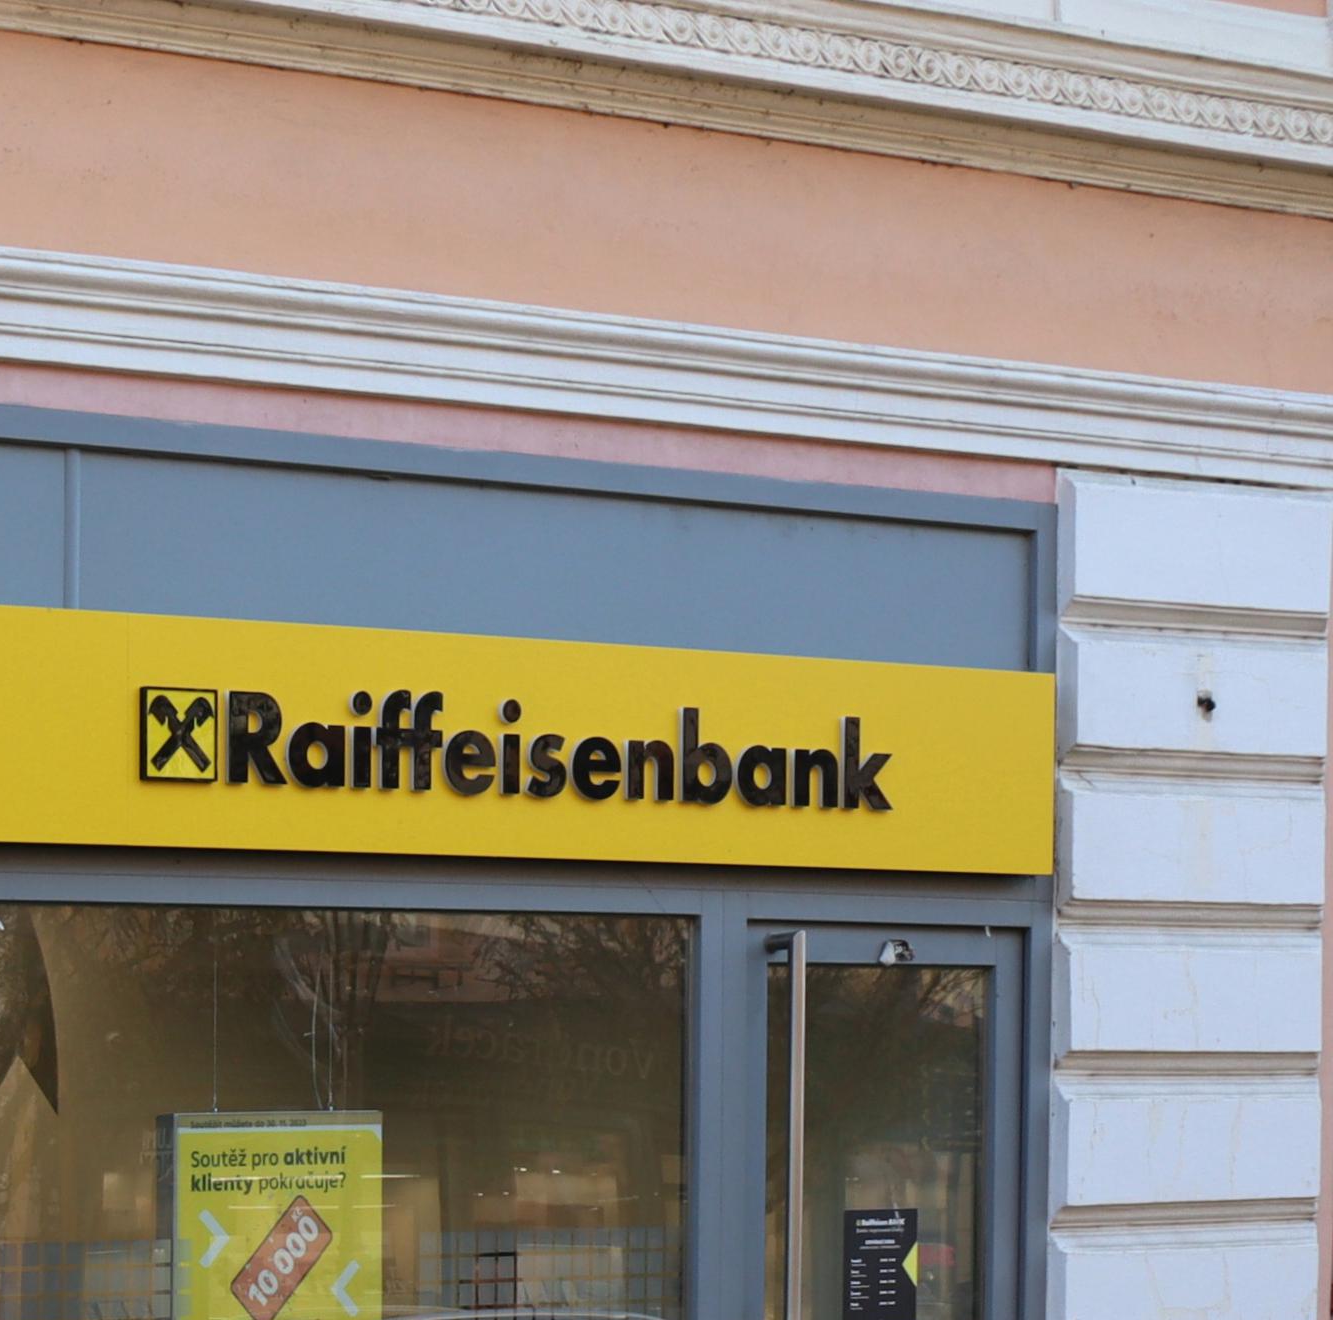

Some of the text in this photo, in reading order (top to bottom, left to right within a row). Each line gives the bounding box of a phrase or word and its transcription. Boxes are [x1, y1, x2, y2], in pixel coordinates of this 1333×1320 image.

[225, 689, 893, 812] Raiffeisenbank
[191, 1146, 347, 1170] Soutěž pro aktivní
[191, 1174, 253, 1196] klienty
[248, 1215, 319, 1307] 10 000
